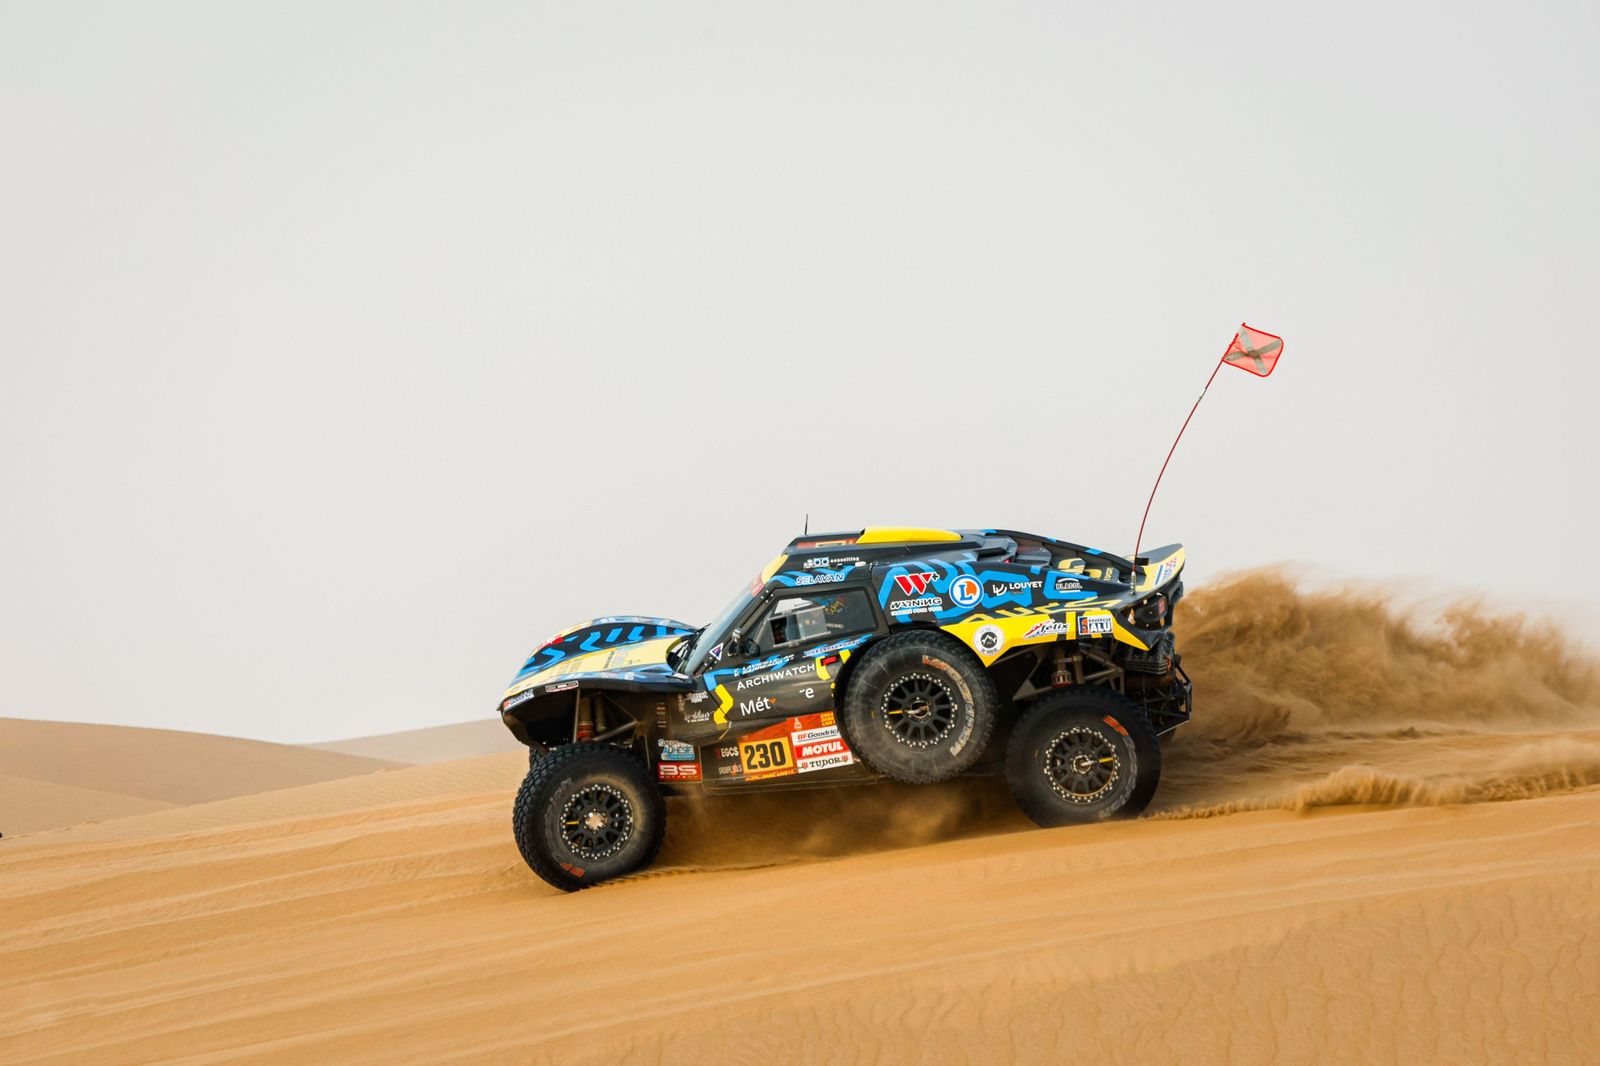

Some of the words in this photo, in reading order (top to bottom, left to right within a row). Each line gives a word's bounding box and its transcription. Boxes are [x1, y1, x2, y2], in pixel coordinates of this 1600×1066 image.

[796, 573, 845, 585] SELAVAN
[1009, 580, 1043, 590] LOUYET
[1089, 622, 1111, 632] ALU
[737, 664, 815, 691] ARCHIWATCH
[802, 741, 843, 756] MOTUL
[744, 741, 786, 770] 230
[809, 757, 841, 768] TUDOR
